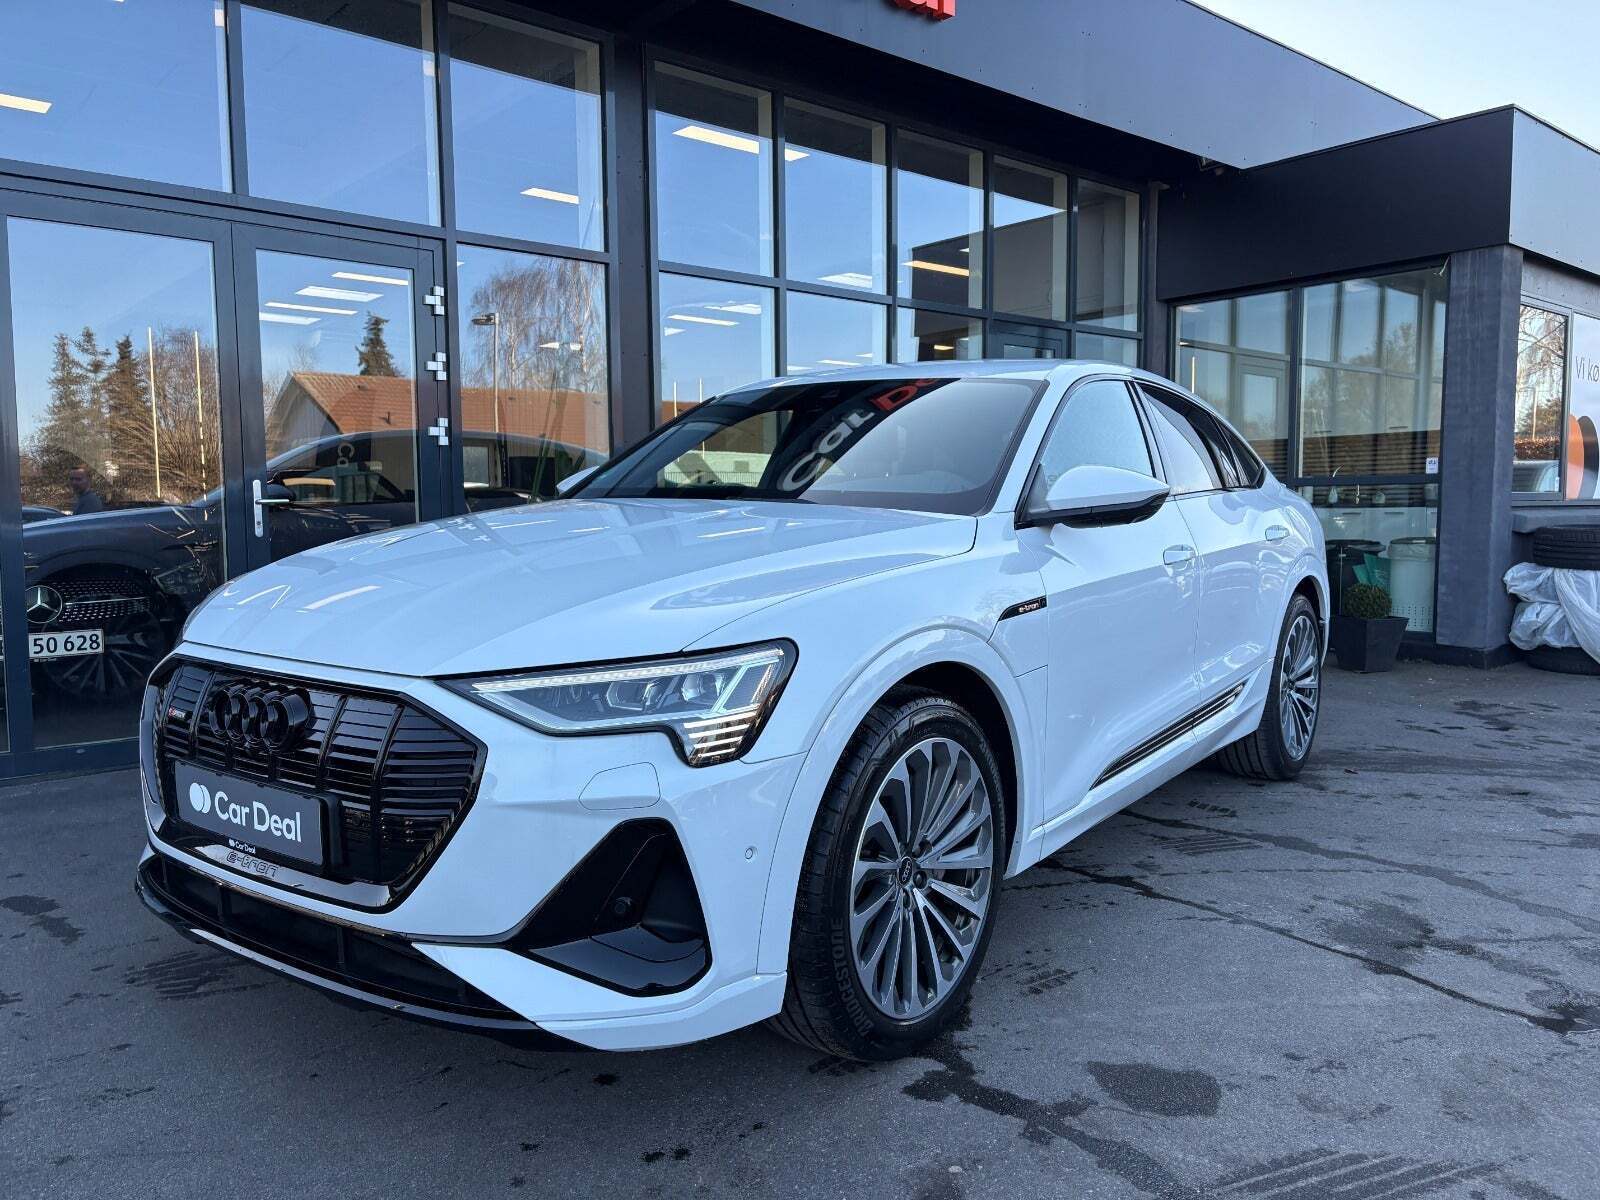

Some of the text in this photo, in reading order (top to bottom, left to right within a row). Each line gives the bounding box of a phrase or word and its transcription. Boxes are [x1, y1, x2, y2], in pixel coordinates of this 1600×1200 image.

[1575, 355, 1585, 380] Vi
[33, 633, 101, 654] 50 628
[214, 791, 302, 842] Car Deal
